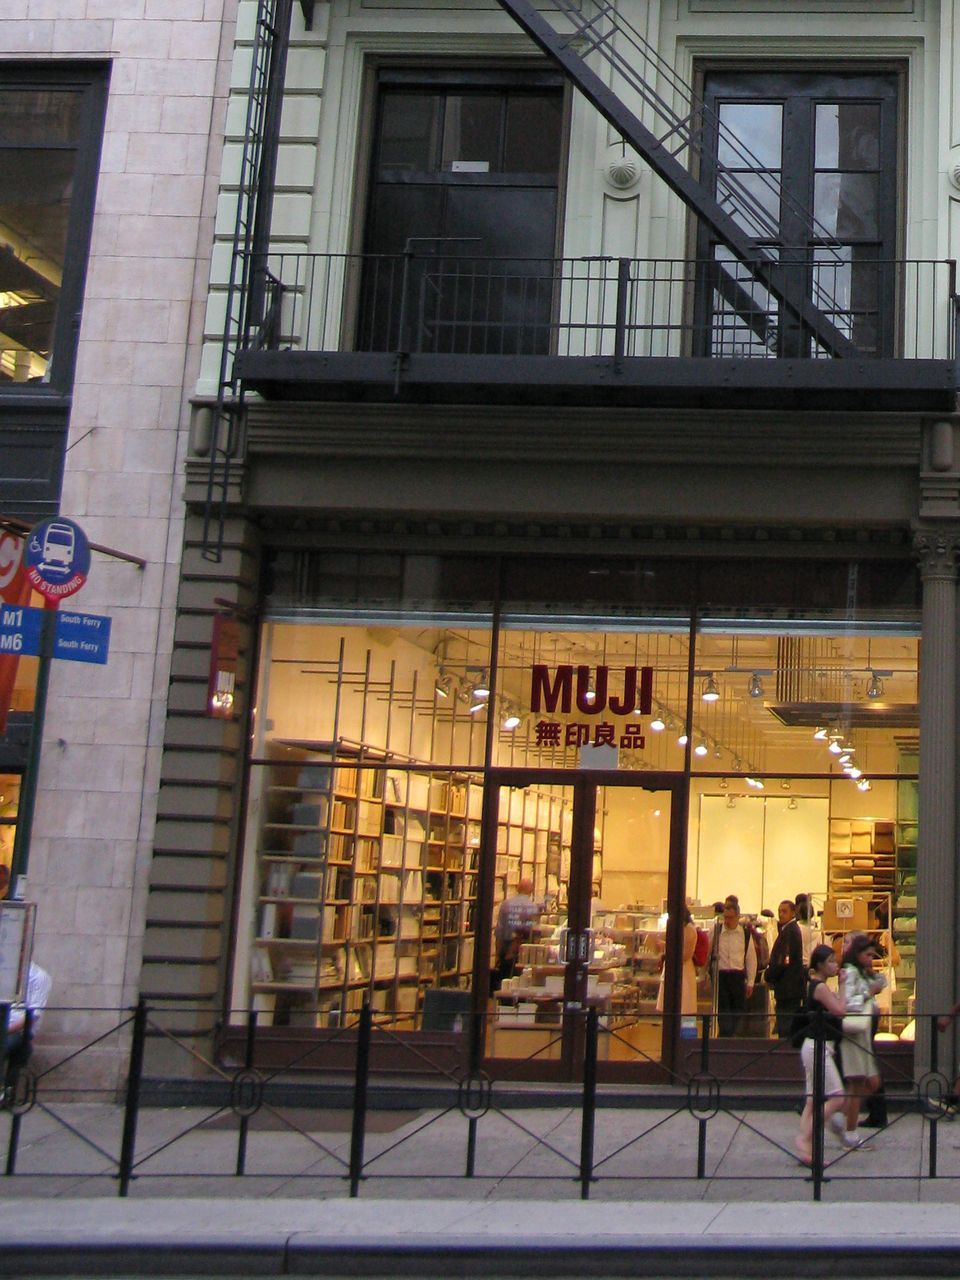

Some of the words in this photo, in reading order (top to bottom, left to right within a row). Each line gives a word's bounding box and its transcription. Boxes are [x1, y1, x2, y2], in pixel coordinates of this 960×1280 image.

[28, 568, 42, 584] NO
[40, 575, 82, 594] STANDING
[3, 609, 24, 627] M1
[60, 614, 81, 625] South
[82, 616, 102, 629] Ferry
[0, 633, 23, 651] M6
[58, 639, 79, 649] South
[79, 641, 100, 653] Ferry
[530, 664, 654, 716] MUJI
[535, 720, 646, 750] 無印良品
